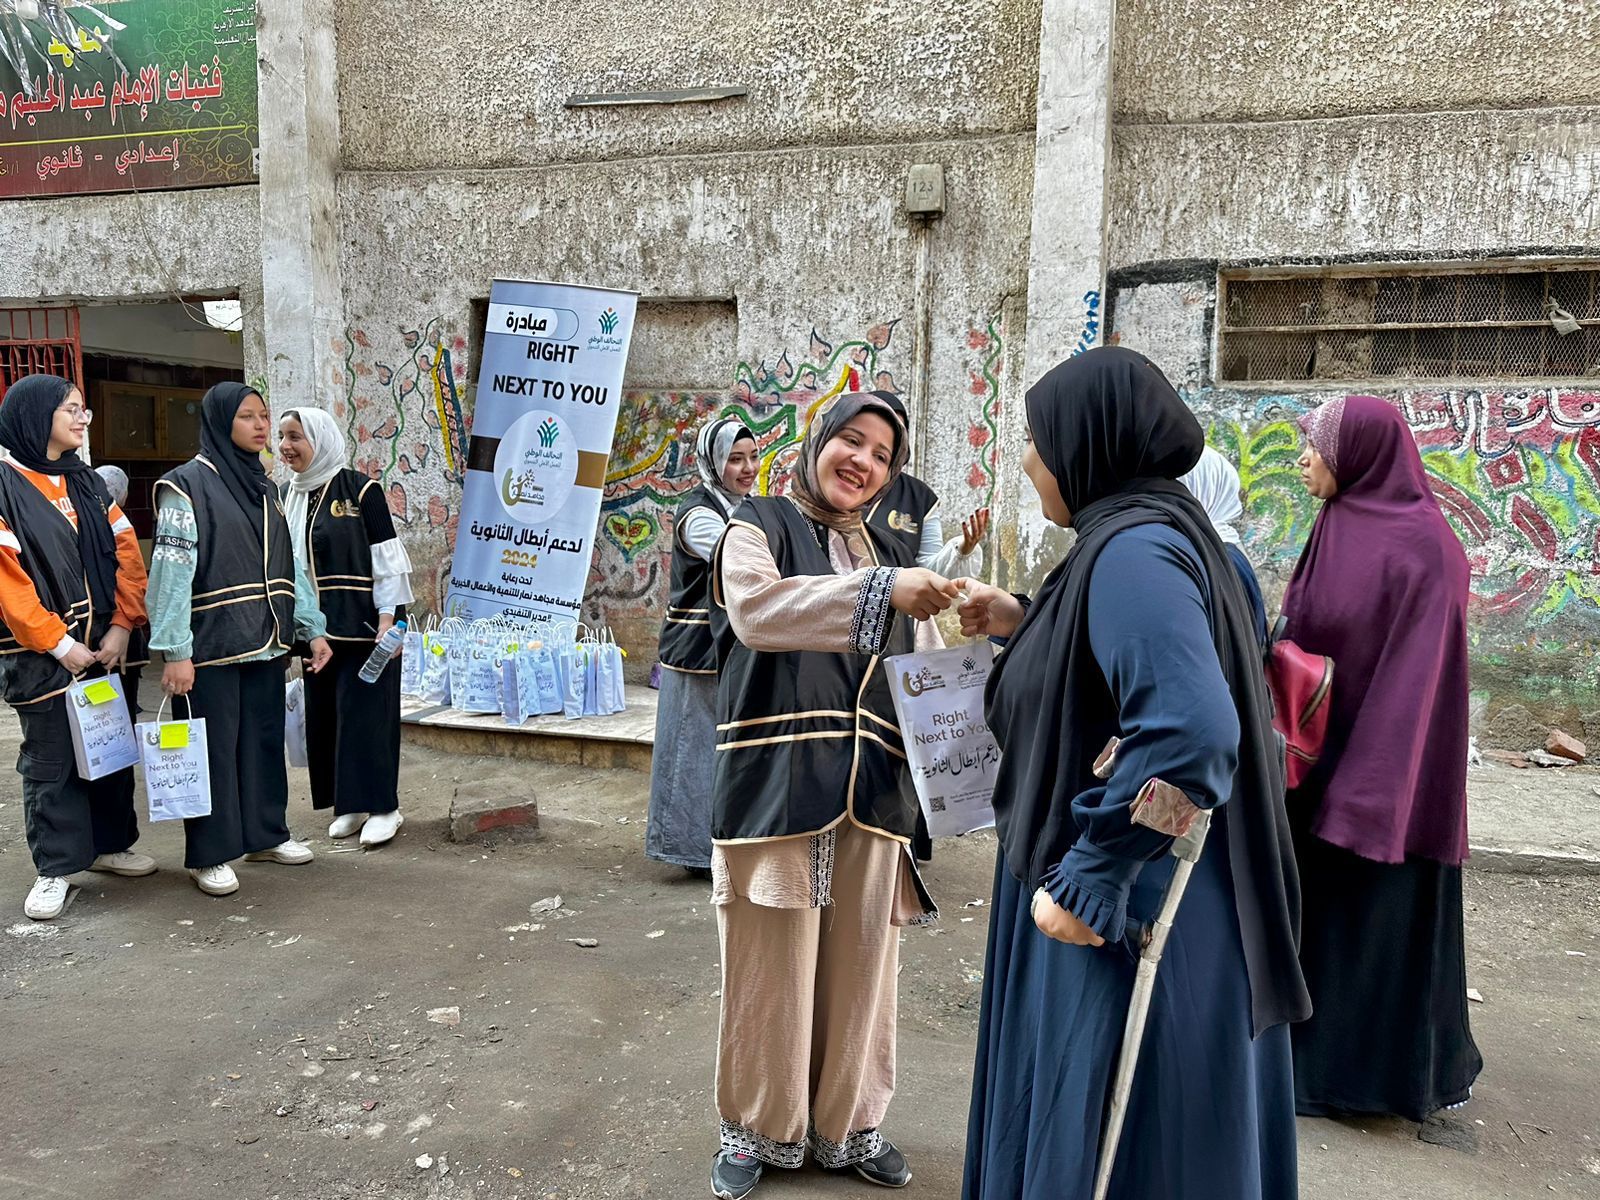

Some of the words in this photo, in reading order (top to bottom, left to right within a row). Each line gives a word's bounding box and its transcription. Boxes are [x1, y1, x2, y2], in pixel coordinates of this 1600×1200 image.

[165, 55, 223, 112] فتيات
[70, 81, 107, 122] عبد
[110, 64, 160, 126] الإمام
[36, 145, 84, 181] ثانوي
[115, 138, 180, 176] إعدادي
[912, 181, 934, 193] 123
[506, 311, 548, 335] مبادرة
[527, 341, 580, 364] RIGHT
[492, 374, 538, 396] NEXT
[541, 379, 565, 400] TO
[570, 383, 608, 406] YOU
[470, 520, 514, 542] الثانوية
[513, 528, 550, 551] أبطال
[547, 537, 583, 555] لدعم
[501, 549, 538, 569] 2024
[501, 571, 519, 586] رعاية
[519, 576, 534, 586] تحت
[532, 593, 555, 606] مجاهد
[555, 596, 581, 610] مؤسسة
[93, 710, 111, 721] Right
[932, 709, 970, 727] Right
[84, 722, 102, 733] Next
[914, 729, 948, 746] Next
[950, 728, 965, 740] to
[967, 722, 991, 735] You
[149, 763, 169, 772] Next
[181, 760, 197, 768] You
[161, 753, 184, 763] Right
[921, 755, 951, 779] الثانوية
[950, 746, 980, 776] أبطال
[980, 744, 999, 775] لدعم
